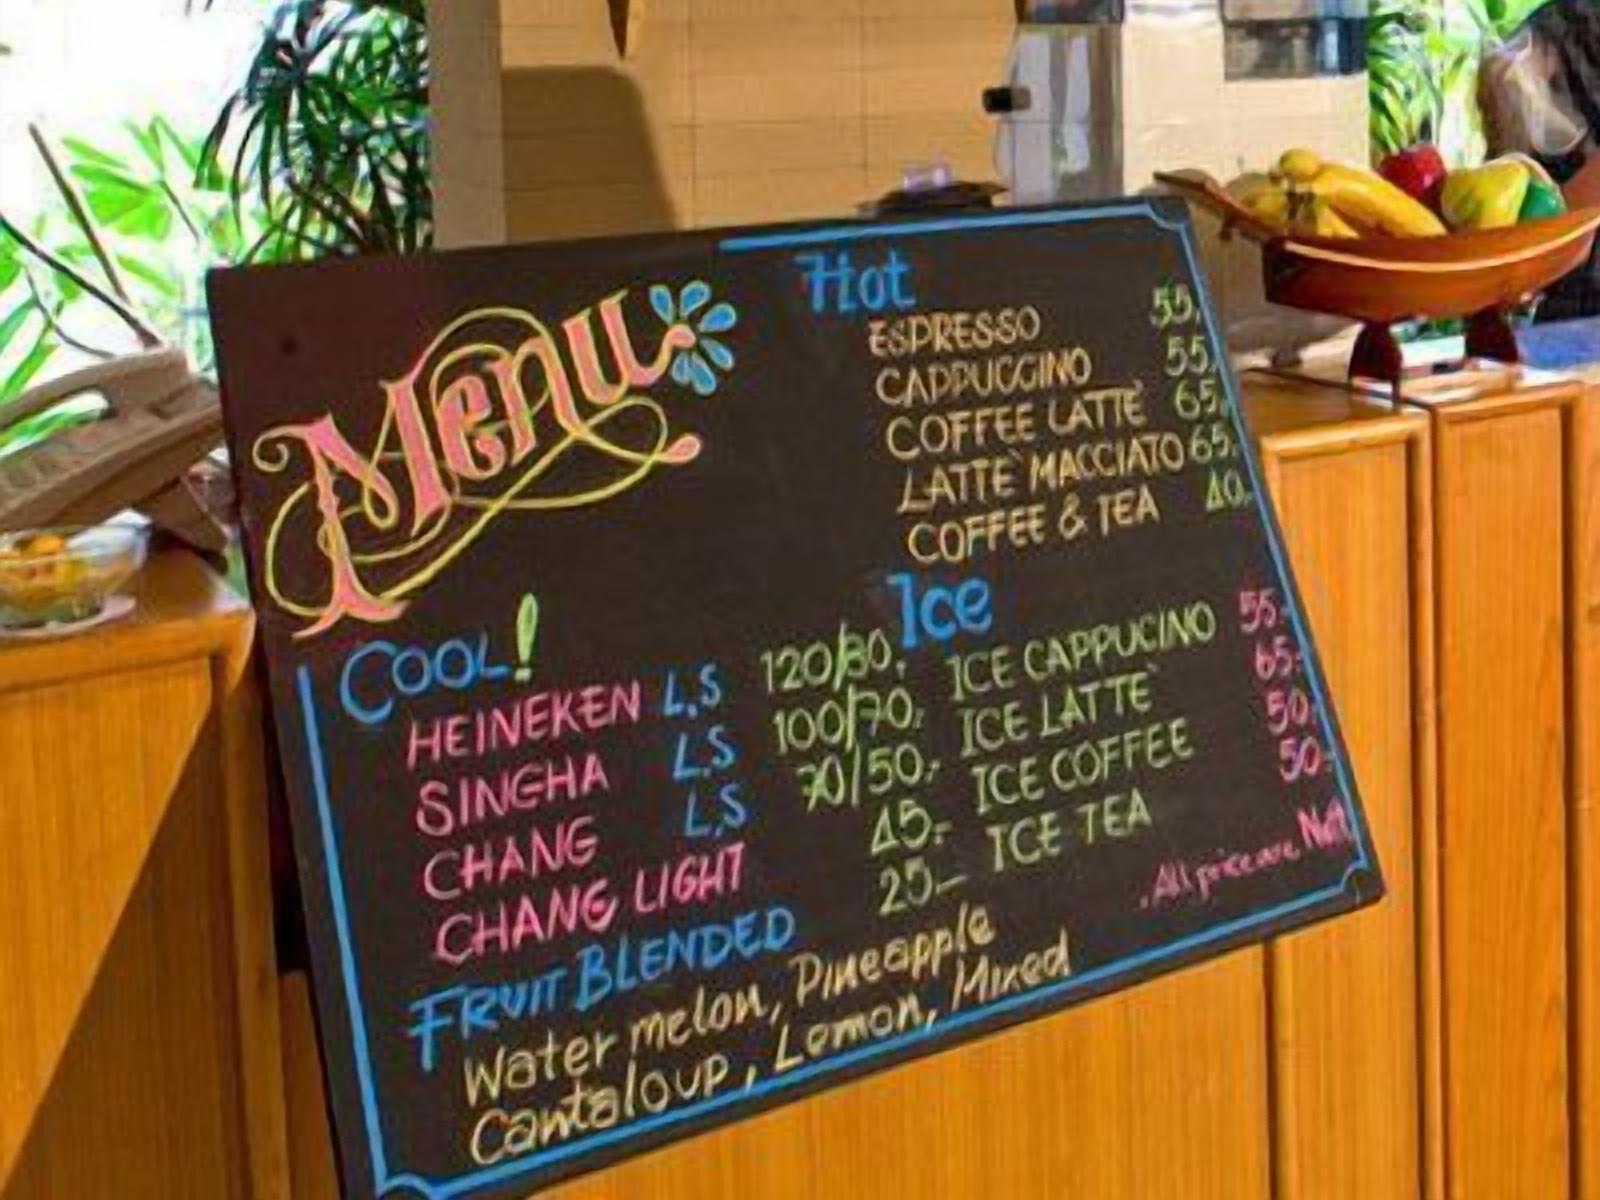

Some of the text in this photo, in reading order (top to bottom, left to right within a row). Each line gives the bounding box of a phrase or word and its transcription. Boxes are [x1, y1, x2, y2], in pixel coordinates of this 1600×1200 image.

[794, 251, 917, 313] Hot
[868, 305, 1041, 358] ESPRESSO
[253, 290, 702, 636] Menu
[886, 401, 1036, 460] COFFEE
[1030, 431, 1185, 492] MACCIATO
[908, 503, 1046, 564] COFFEE
[1058, 491, 1087, 540] &
[1097, 484, 1160, 536] TEA
[887, 572, 992, 648] Ice
[945, 646, 1016, 701] ICE
[1024, 600, 1217, 682] CAPPUCINO
[408, 679, 641, 771] HEINEKEN
[958, 702, 1028, 758] ICE
[972, 757, 1044, 817] ICE
[1050, 717, 1194, 792] COFFEE
[416, 752, 609, 837] SINGHA
[986, 812, 1062, 872] ICE
[1076, 787, 1152, 844] TEA
[424, 815, 598, 899] CHANG
[436, 878, 620, 964] CHANG
[634, 841, 745, 913] LIGHT
[409, 966, 567, 1072] FRUIT
[576, 907, 796, 1011] BLENDED
[463, 1029, 618, 1108] Water
[789, 902, 997, 1007] Pineapple
[952, 927, 1072, 1012] Mixed
